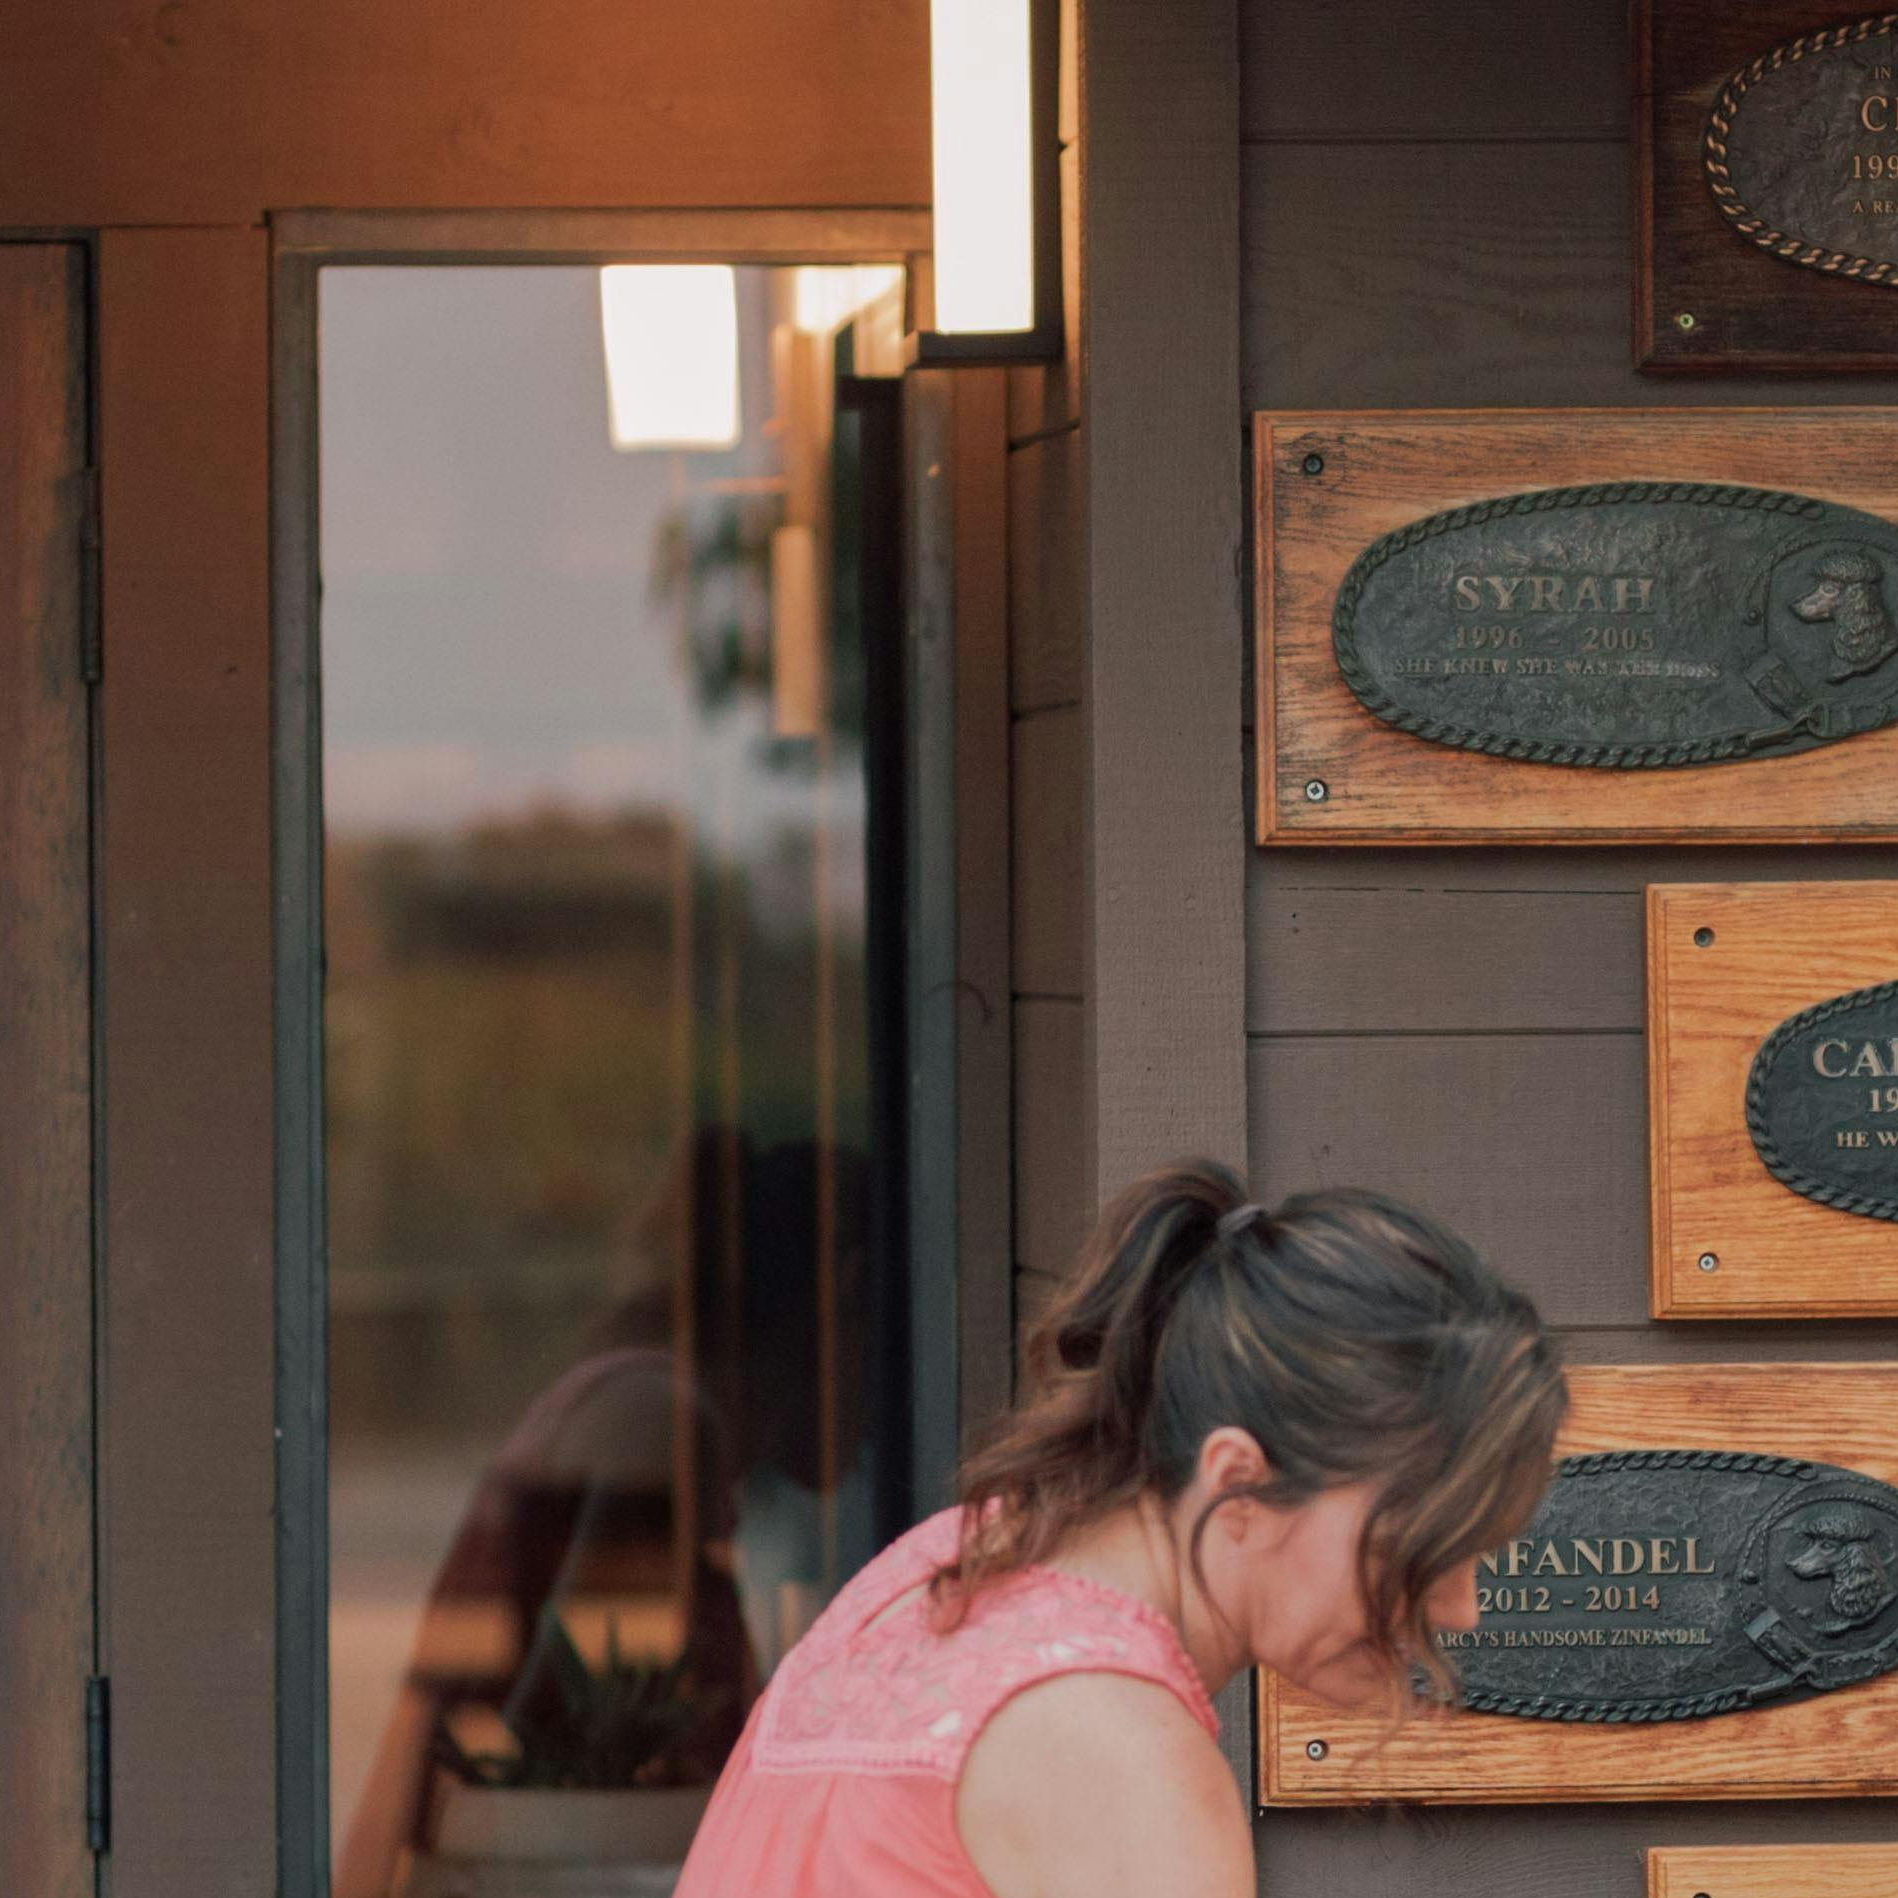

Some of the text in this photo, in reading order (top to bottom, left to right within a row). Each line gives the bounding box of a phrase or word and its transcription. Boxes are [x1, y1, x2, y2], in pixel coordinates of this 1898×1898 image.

[1874, 66, 1892, 80] IN
[1852, 201, 1864, 214] A
[1455, 575, 1655, 615] SYRAH
[1455, 624, 1524, 650] 1996
[1582, 626, 1655, 651] 2005
[1394, 657, 1435, 675] SHE
[1444, 657, 1510, 675] KNEW
[1517, 657, 1558, 675] SHE
[1565, 658, 1608, 675] WAS
[1836, 1131, 1870, 1148] HE
[1474, 1537, 1717, 1578] NFANDEL
[1477, 1586, 1551, 1614] 2012
[1584, 1585, 1662, 1612] 2014
[1434, 1627, 1713, 1649] ARCY'S HANDSOME ZINFANDEL
